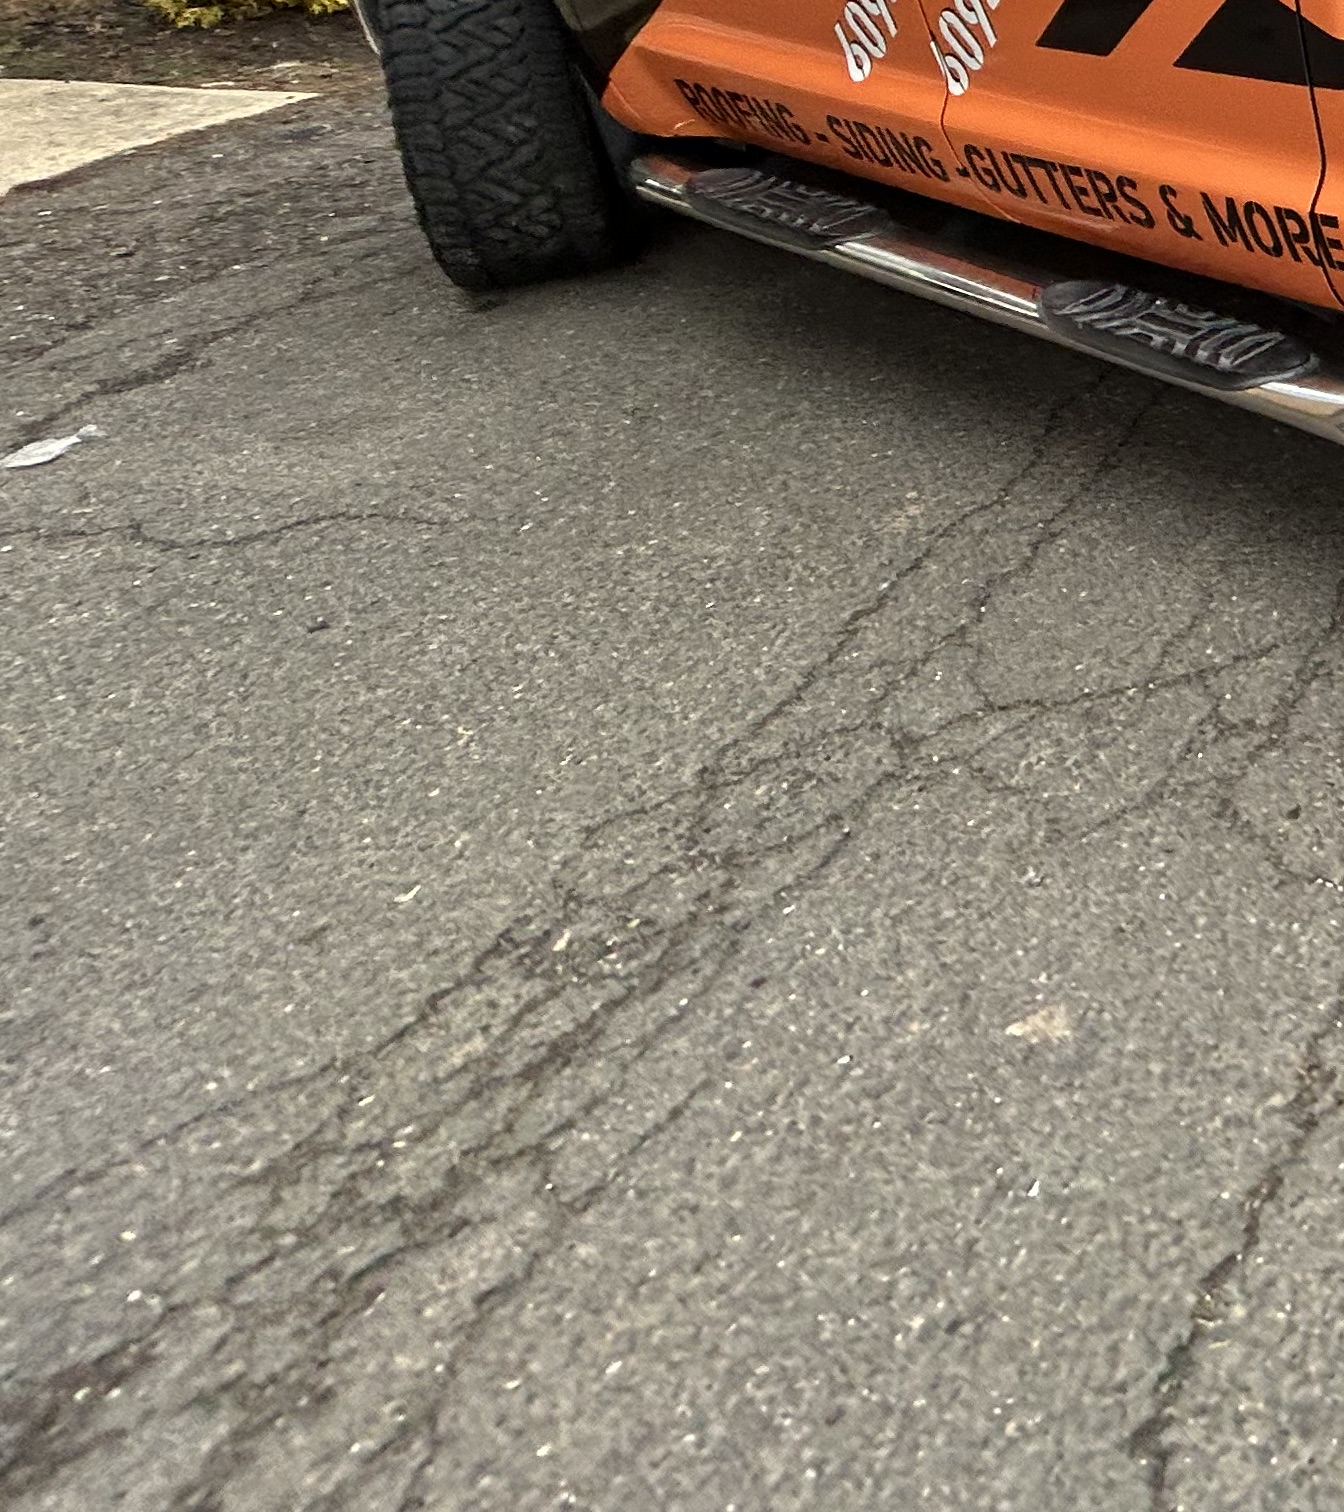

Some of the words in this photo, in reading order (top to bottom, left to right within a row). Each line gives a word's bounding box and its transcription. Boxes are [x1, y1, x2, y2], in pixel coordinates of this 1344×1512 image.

[673, 77, 812, 146] ROOFING
[825, 113, 951, 183] SIDING
[1158, 184, 1203, 242] &
